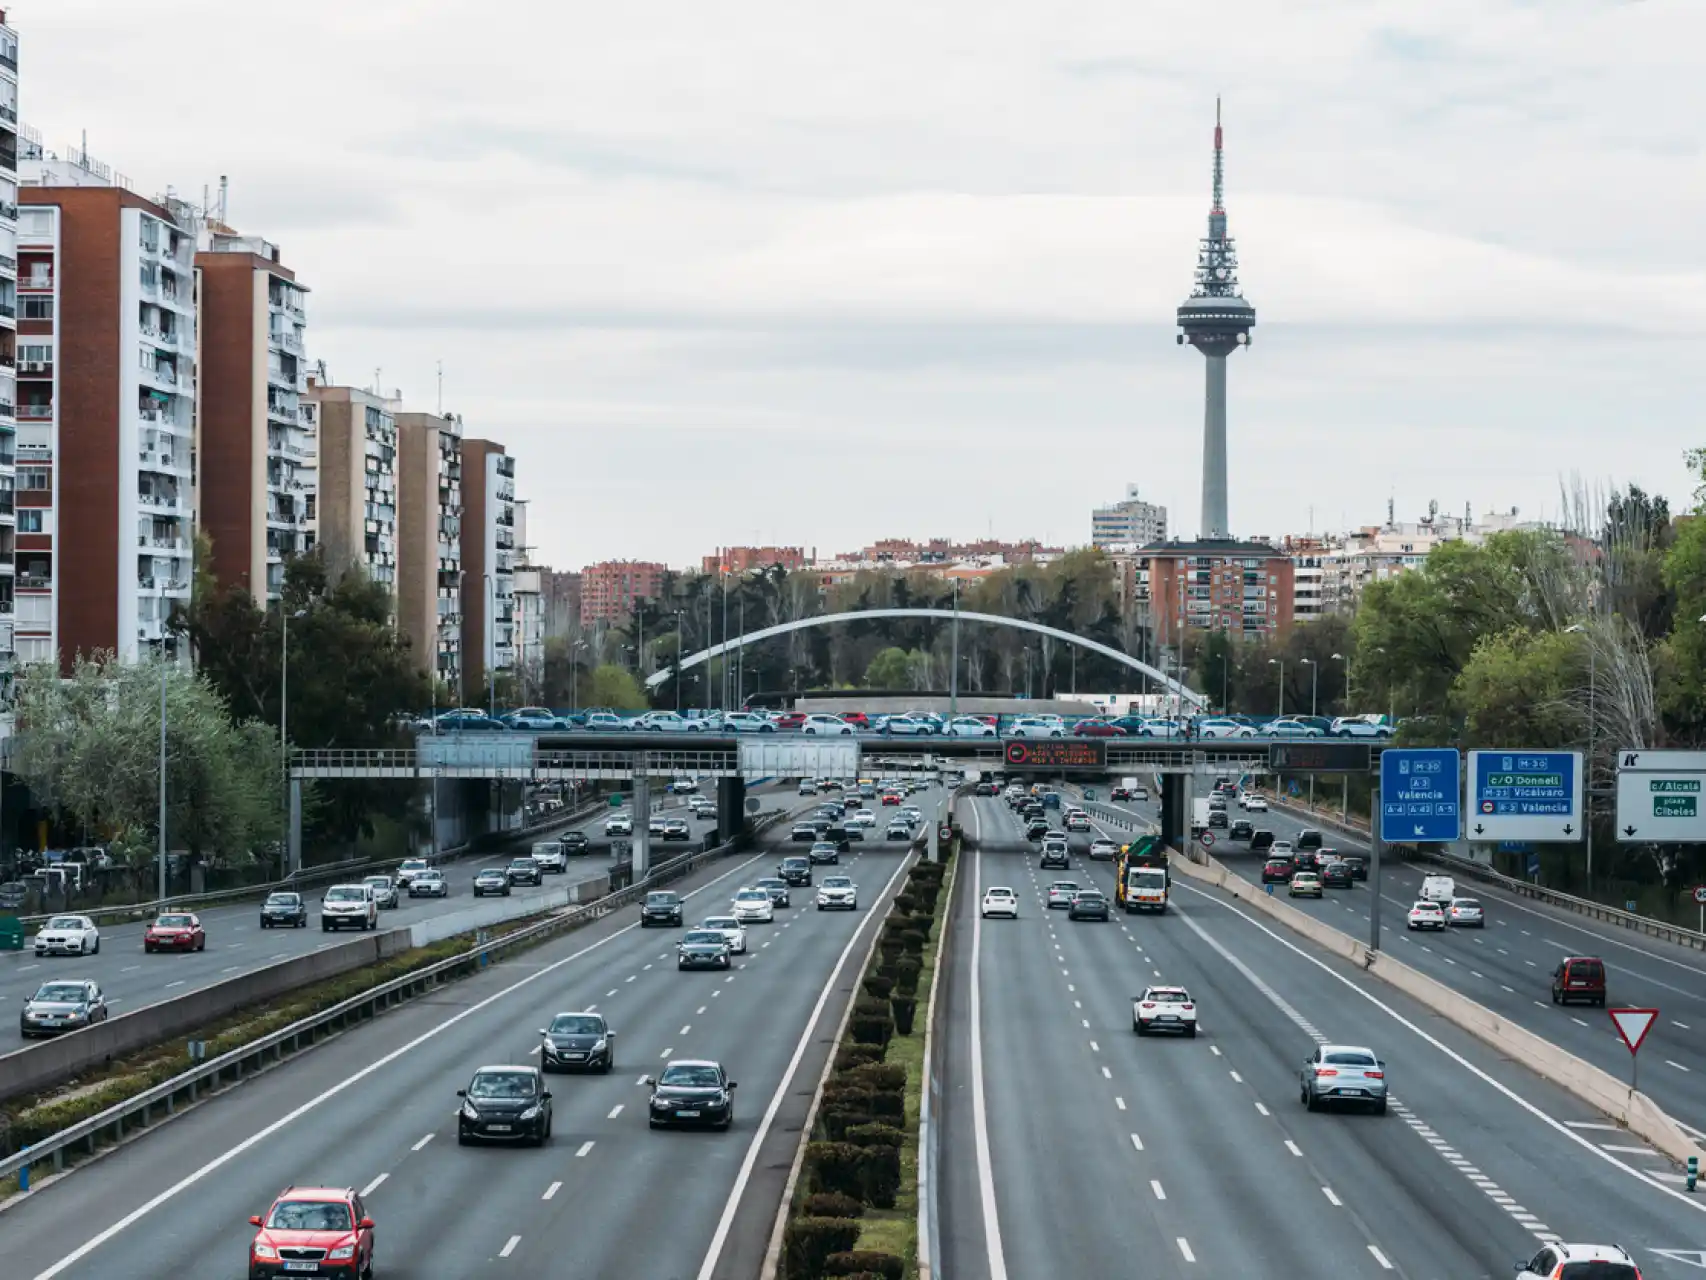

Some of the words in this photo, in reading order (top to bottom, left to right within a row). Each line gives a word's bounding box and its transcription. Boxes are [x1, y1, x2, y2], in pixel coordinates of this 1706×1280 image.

[1415, 762, 1440, 772] M-30
[1520, 759, 1546, 768] M-30
[1397, 790, 1443, 800] Valencia
[1521, 802, 1569, 812] Valencia
[1655, 806, 1695, 816] Cibeles
